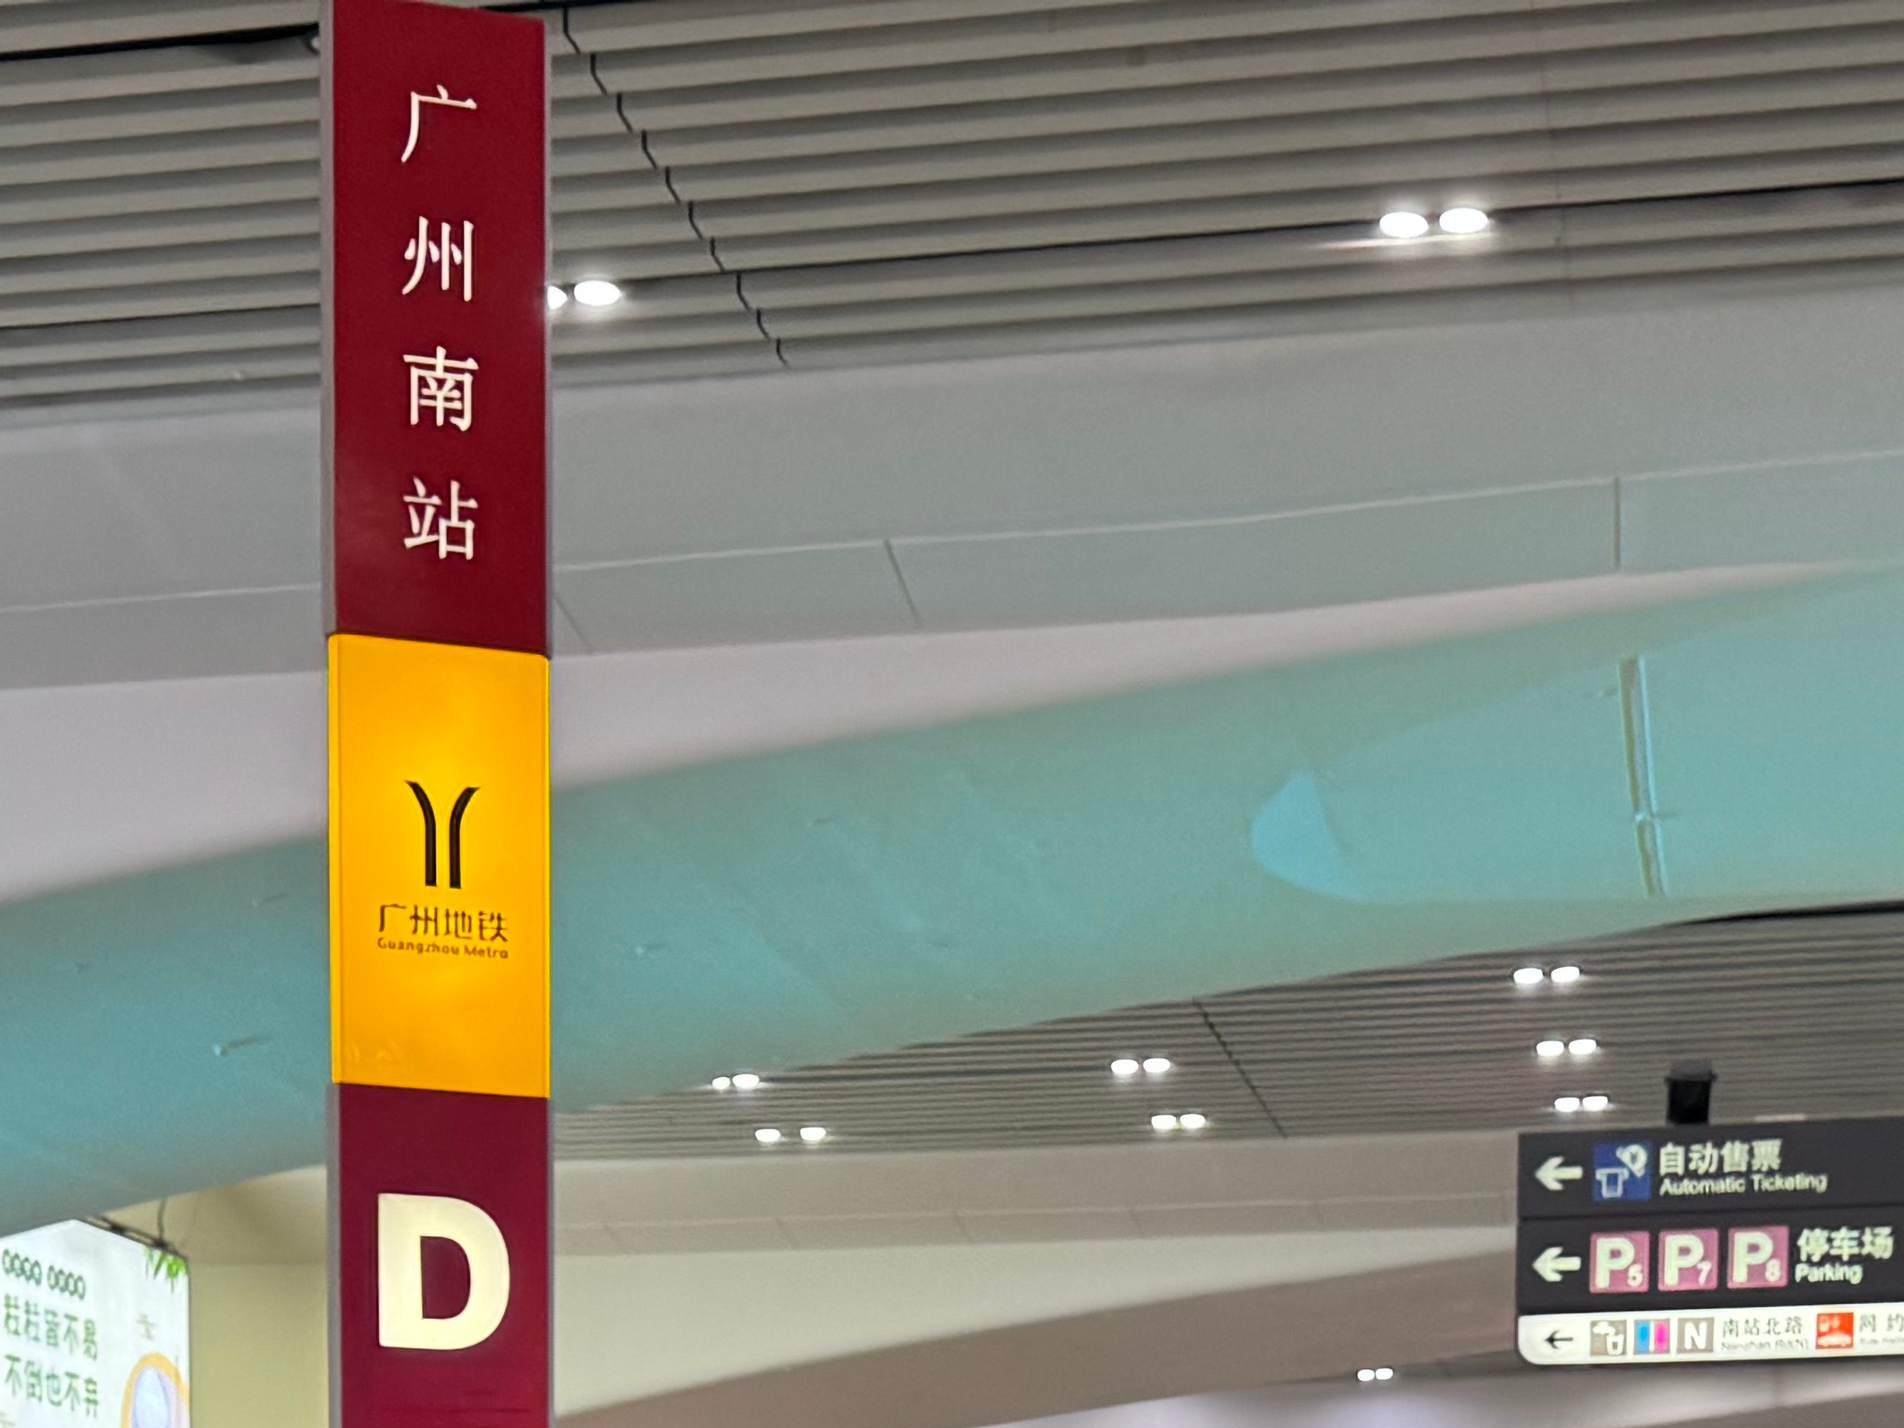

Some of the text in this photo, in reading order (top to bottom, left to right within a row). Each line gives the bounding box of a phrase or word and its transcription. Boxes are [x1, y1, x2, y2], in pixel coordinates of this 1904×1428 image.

[400, 83, 480, 561] 广州南站
[378, 903, 508, 942] 广州地铁
[377, 937, 509, 959] Guangzhou Metro
[1659, 1139, 1782, 1176] 自动售票
[1660, 1173, 1828, 1196] Automatic Ticketing
[1797, 1226, 1894, 1262] 停车场
[378, 1192, 510, 1350] D
[1795, 1262, 1863, 1285] Parking
[1722, 1316, 1803, 1338] 南站北路
